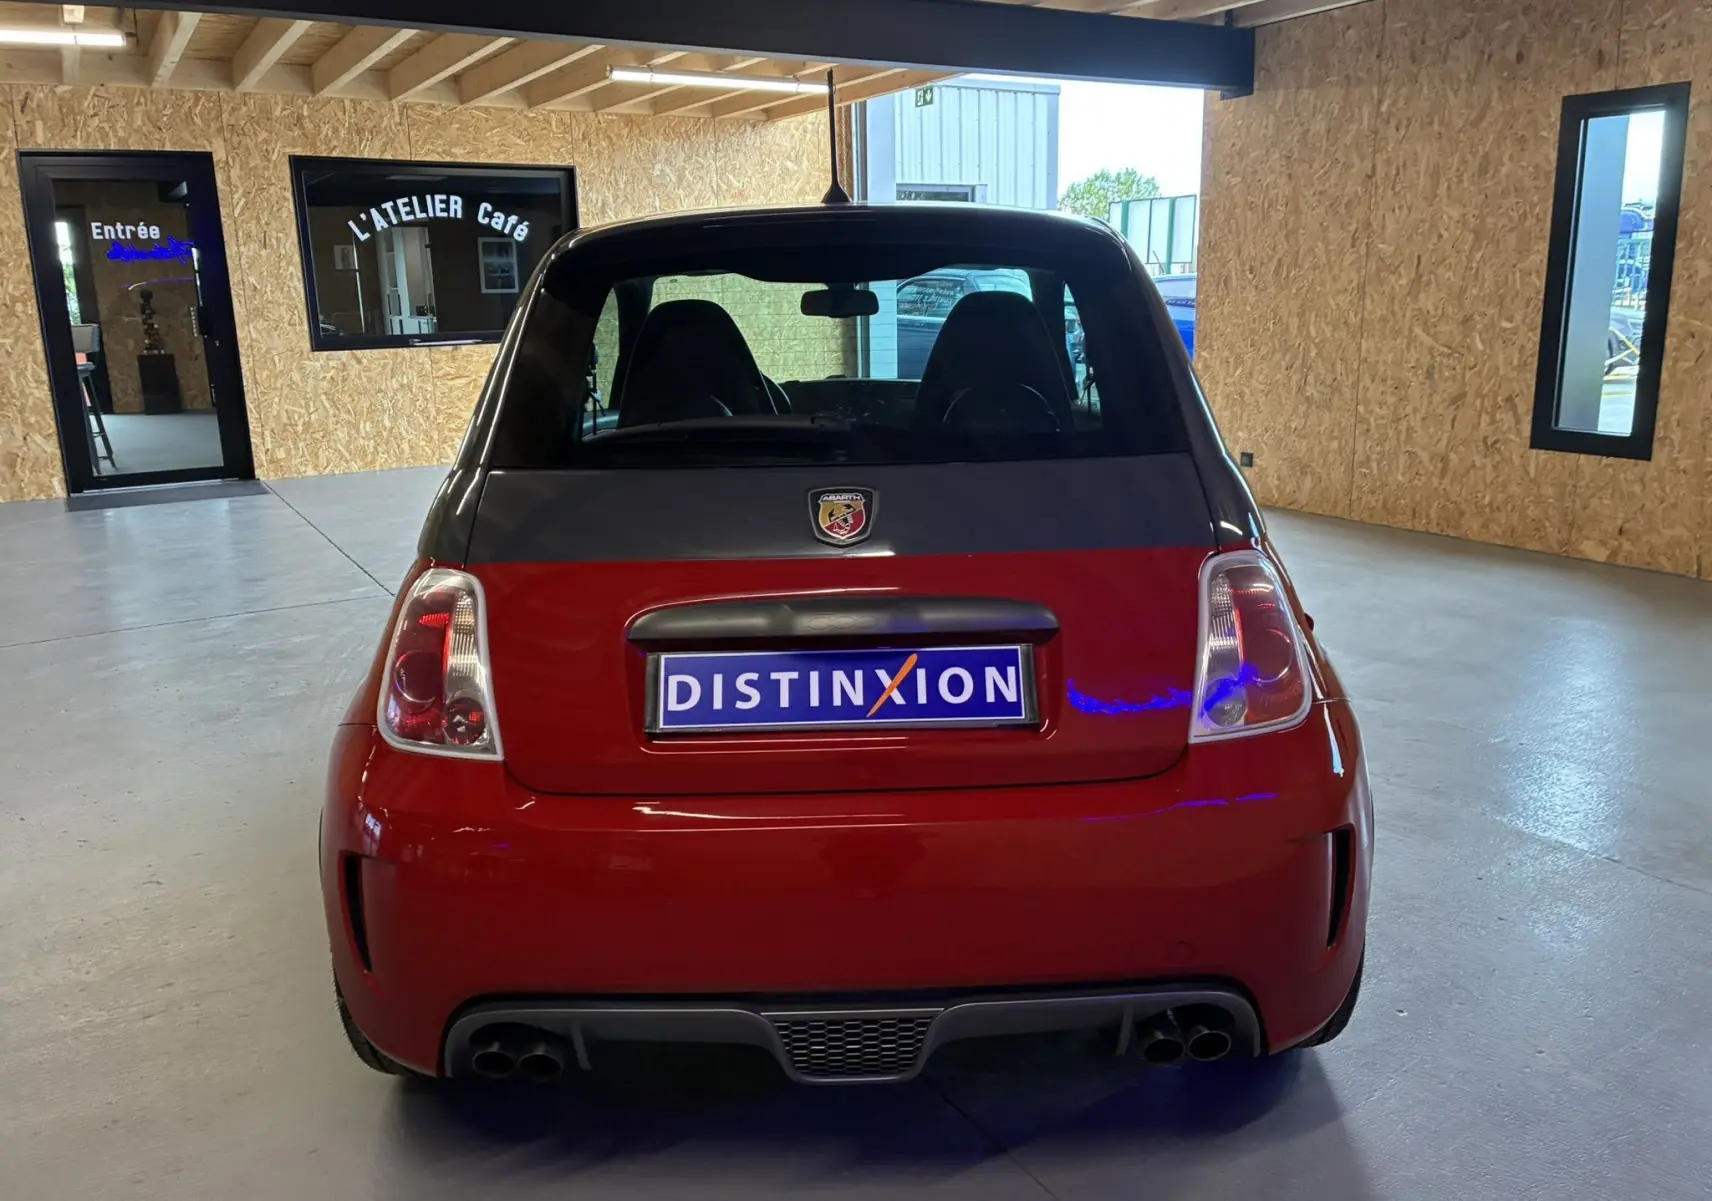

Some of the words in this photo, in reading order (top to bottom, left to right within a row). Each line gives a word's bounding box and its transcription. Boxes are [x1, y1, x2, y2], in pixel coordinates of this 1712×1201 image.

[90, 221, 161, 240] Entrée
[347, 194, 463, 242] L'ATELIER
[476, 202, 530, 242] Café
[667, 654, 1019, 717] DISTINXION
